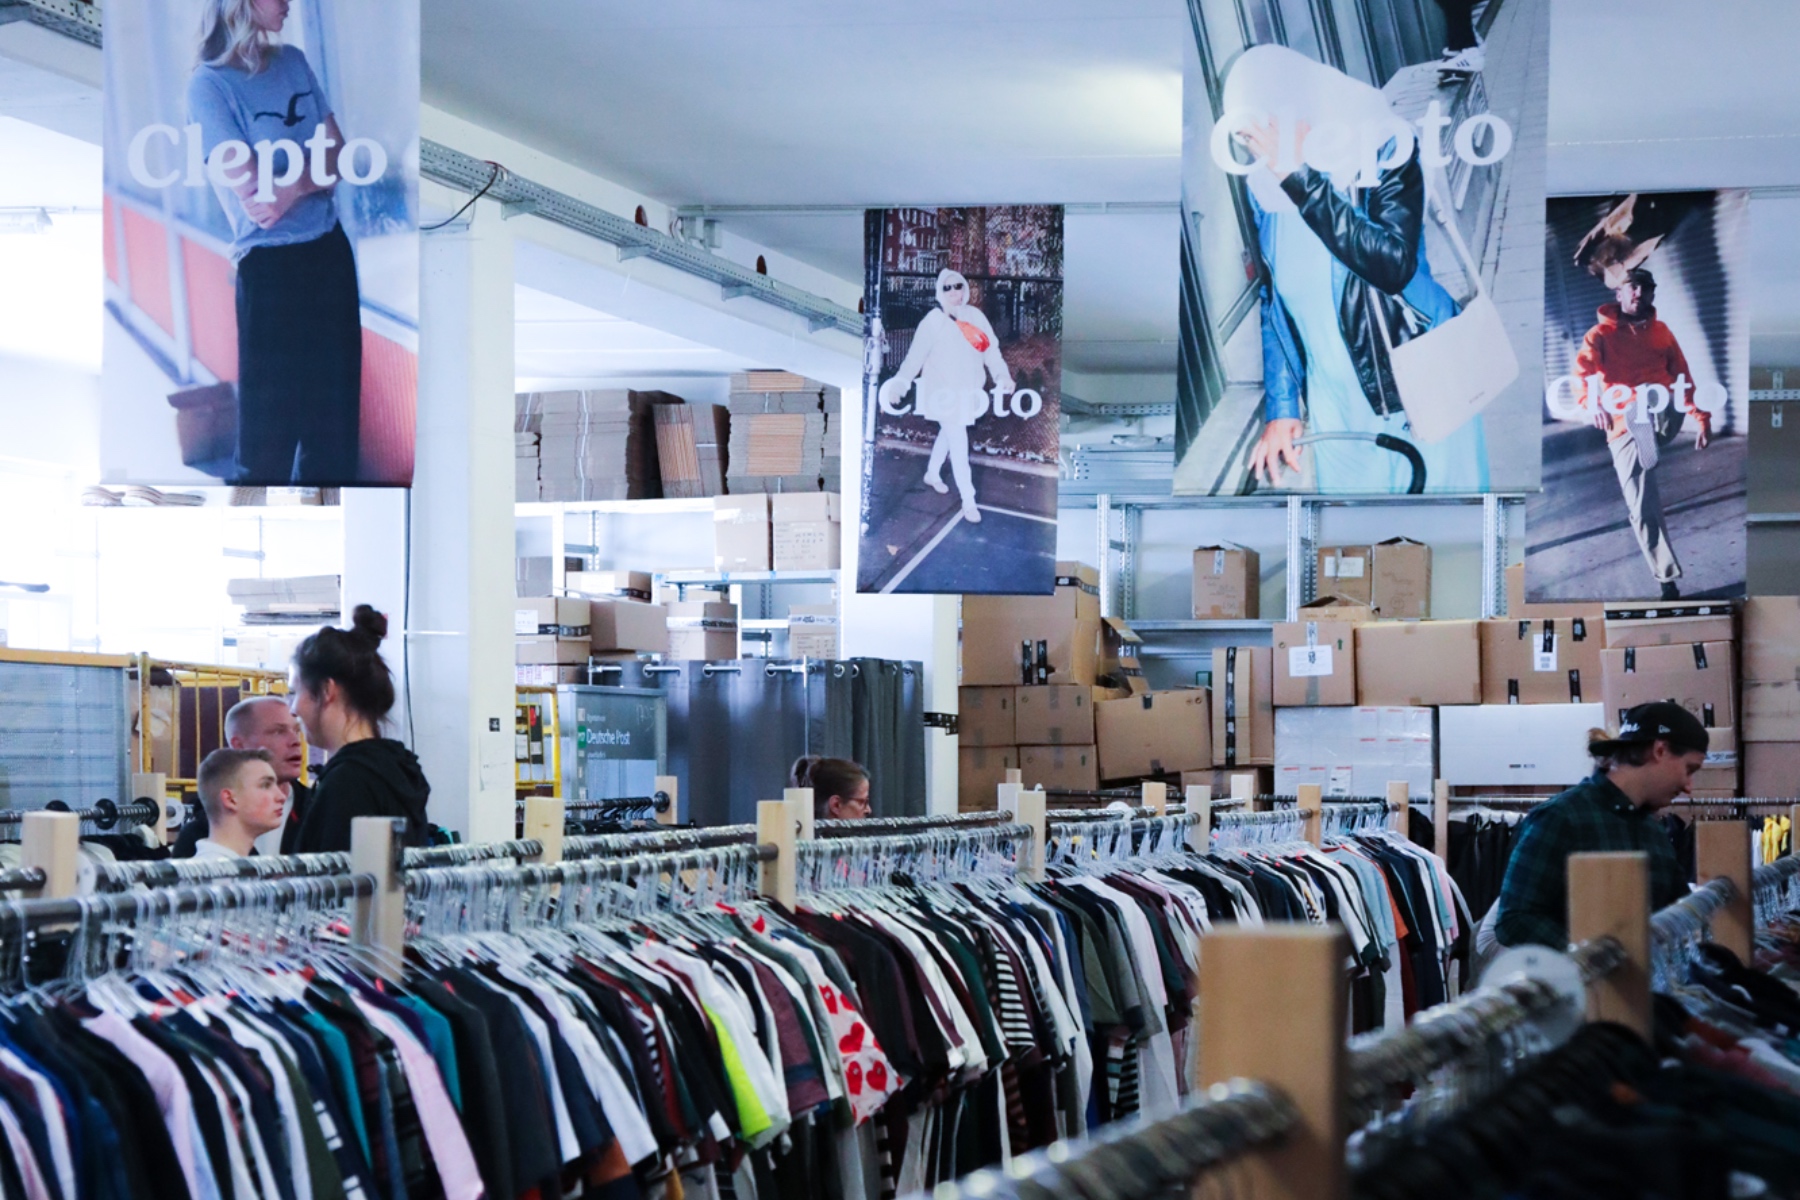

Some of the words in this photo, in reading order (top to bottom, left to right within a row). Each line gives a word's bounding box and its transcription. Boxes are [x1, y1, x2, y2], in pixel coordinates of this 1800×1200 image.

[128, 122, 388, 202] Clepto
[1546, 373, 1728, 424] Clepto
[586, 728, 616, 745] Deutsche
[616, 729, 631, 745] Post
